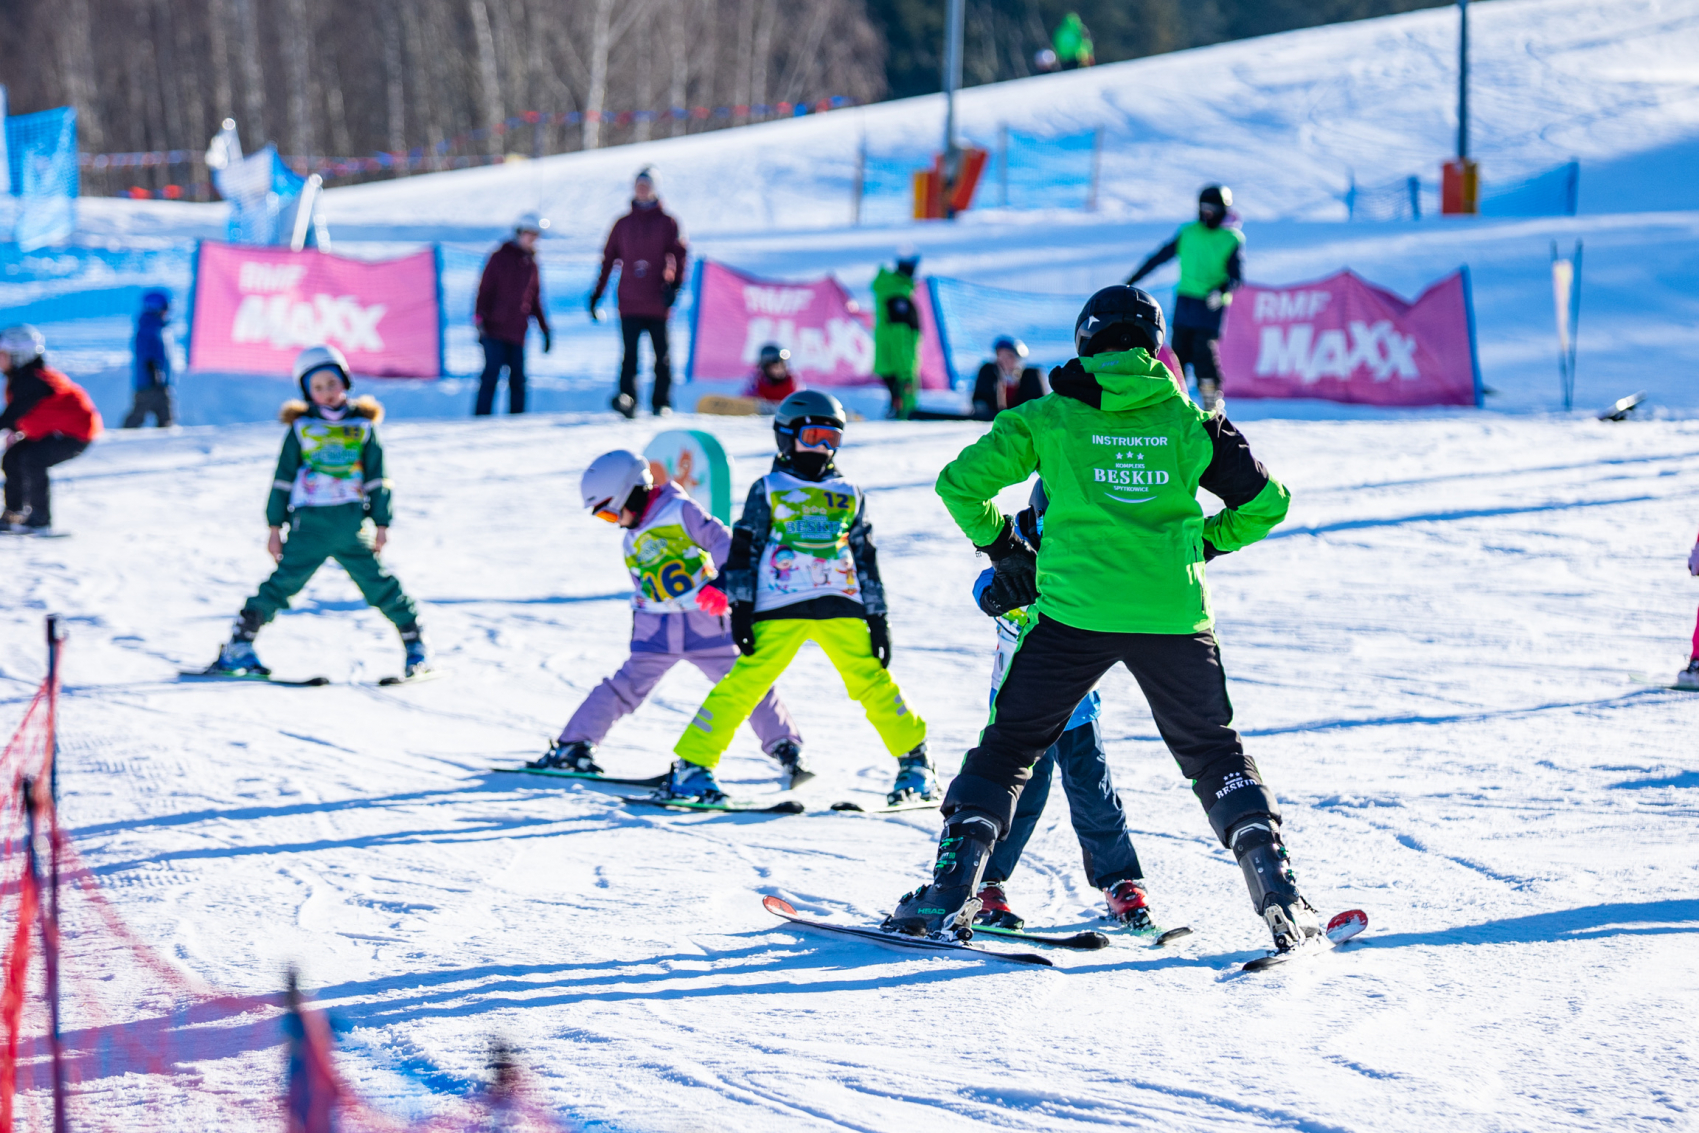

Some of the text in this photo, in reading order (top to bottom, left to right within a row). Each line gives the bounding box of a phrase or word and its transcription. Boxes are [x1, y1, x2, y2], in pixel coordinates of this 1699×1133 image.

[1254, 290, 1331, 320] RMF
[1092, 434, 1168, 447] INSTRUKTOR
[1093, 467, 1170, 485] BESKID
[823, 491, 850, 509] 12
[643, 560, 695, 602] 16
[917, 907, 946, 915] HEAD
